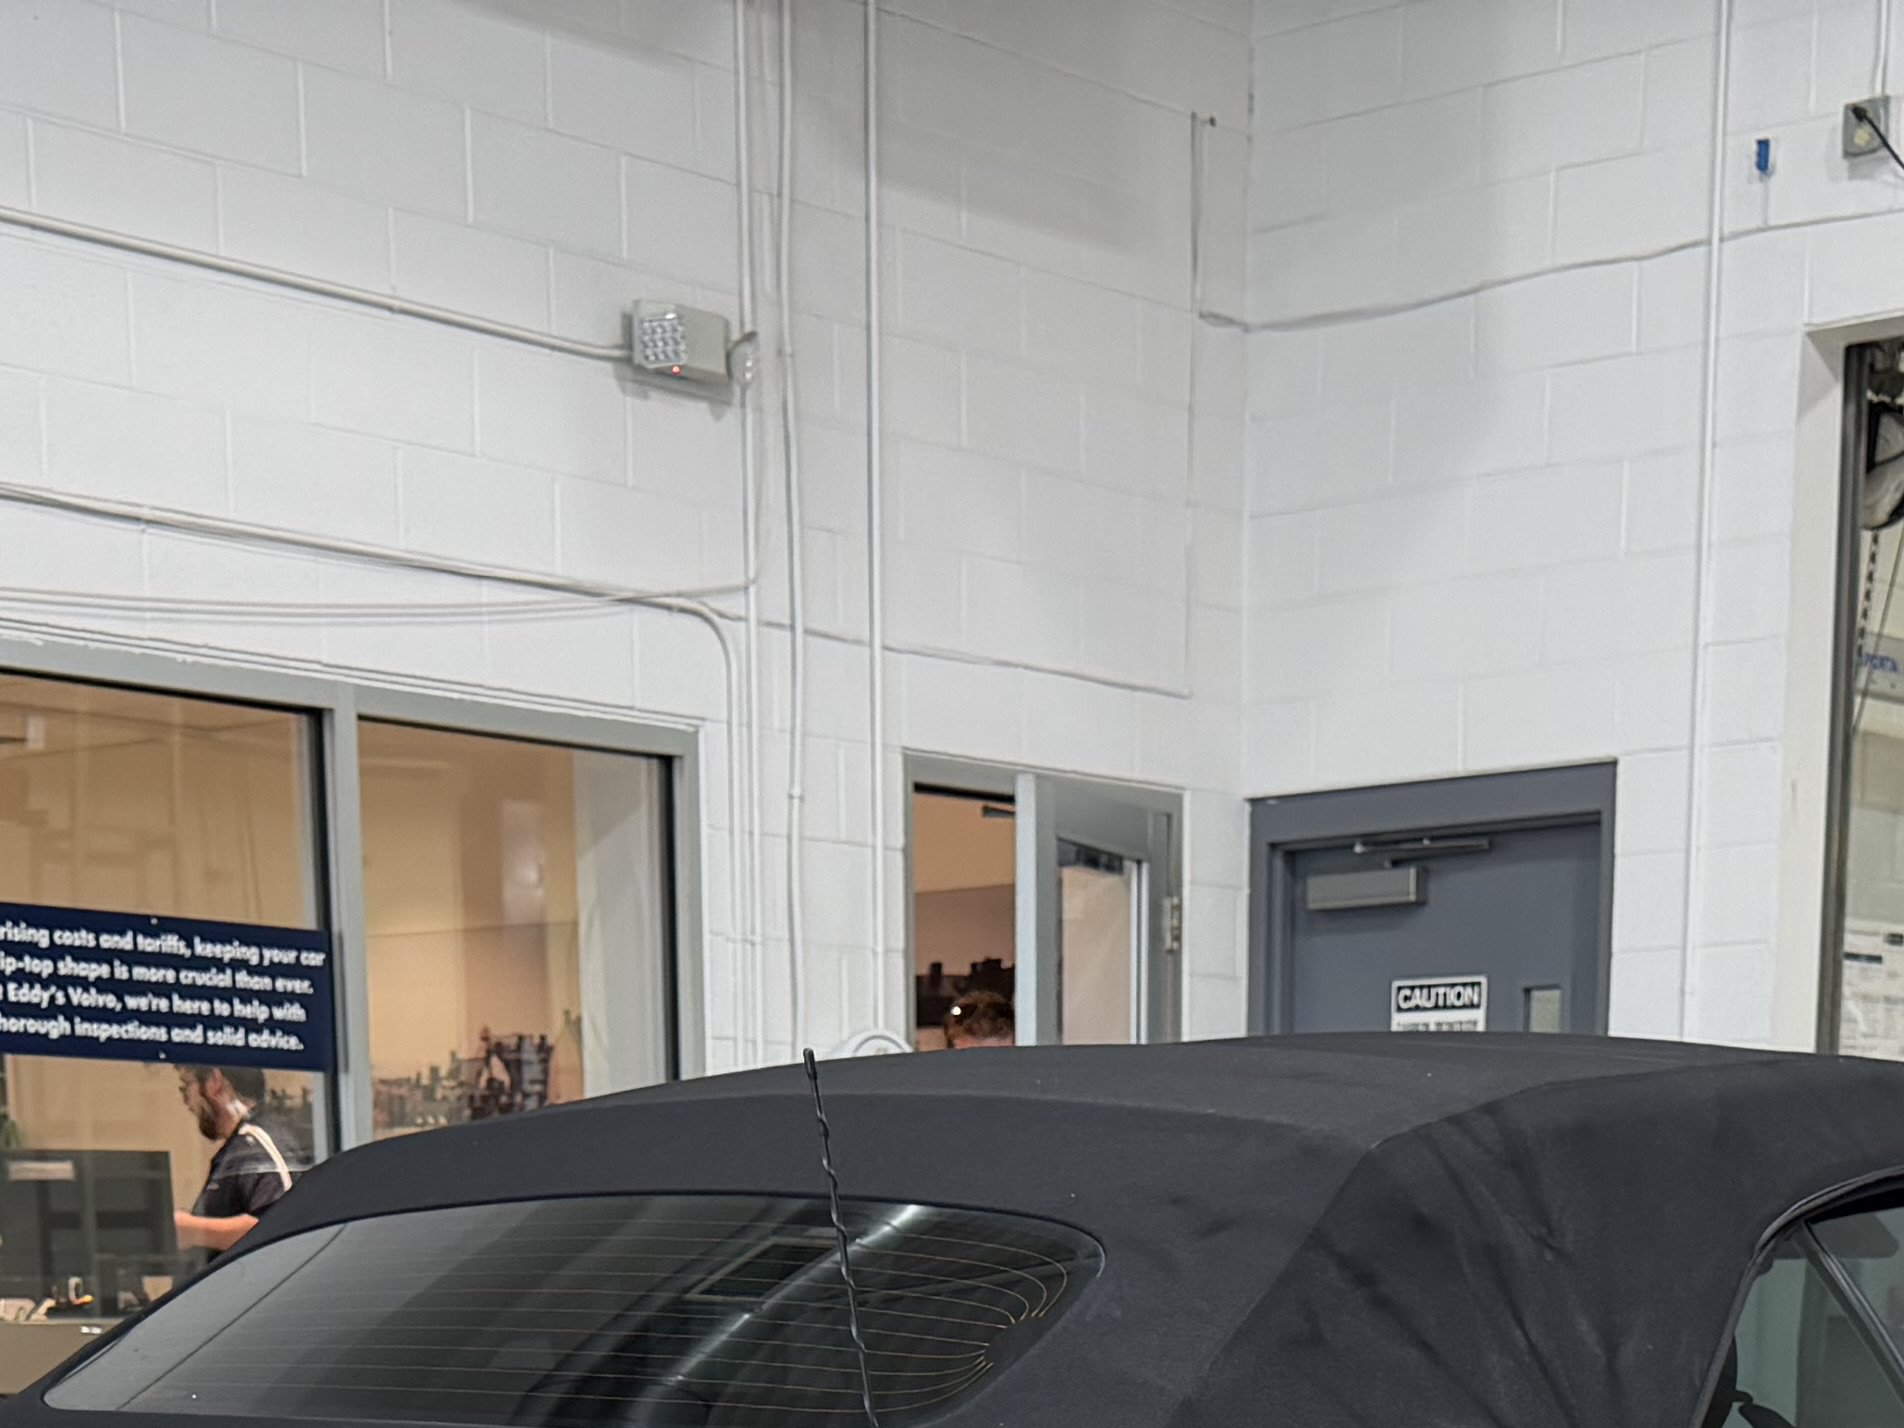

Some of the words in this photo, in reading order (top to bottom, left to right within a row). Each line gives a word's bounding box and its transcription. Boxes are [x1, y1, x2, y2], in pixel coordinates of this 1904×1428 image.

[53, 929, 96, 948] costs
[99, 930, 133, 950] and
[136, 933, 192, 958] tariffs,
[194, 936, 259, 965] keeping
[262, 948, 298, 966] your
[300, 951, 326, 967] car
[57, 955, 110, 981] shape
[113, 960, 129, 980] is
[132, 965, 176, 983] more
[179, 967, 233, 987] crucial
[235, 969, 273, 991] than
[275, 978, 314, 994] ever.
[7, 982, 65, 1009] Eddy's
[68, 986, 122, 1012] Volvo,
[124, 993, 169, 1012] we're
[172, 993, 210, 1015] here
[213, 999, 231, 1017] to
[233, 997, 269, 1023] help
[272, 1002, 307, 1022] with
[1398, 985, 1481, 1009] CAUTION
[74, 1016, 168, 1043] inspections
[171, 1023, 204, 1043] and
[207, 1026, 245, 1047] solid
[248, 1029, 304, 1051] advice.
